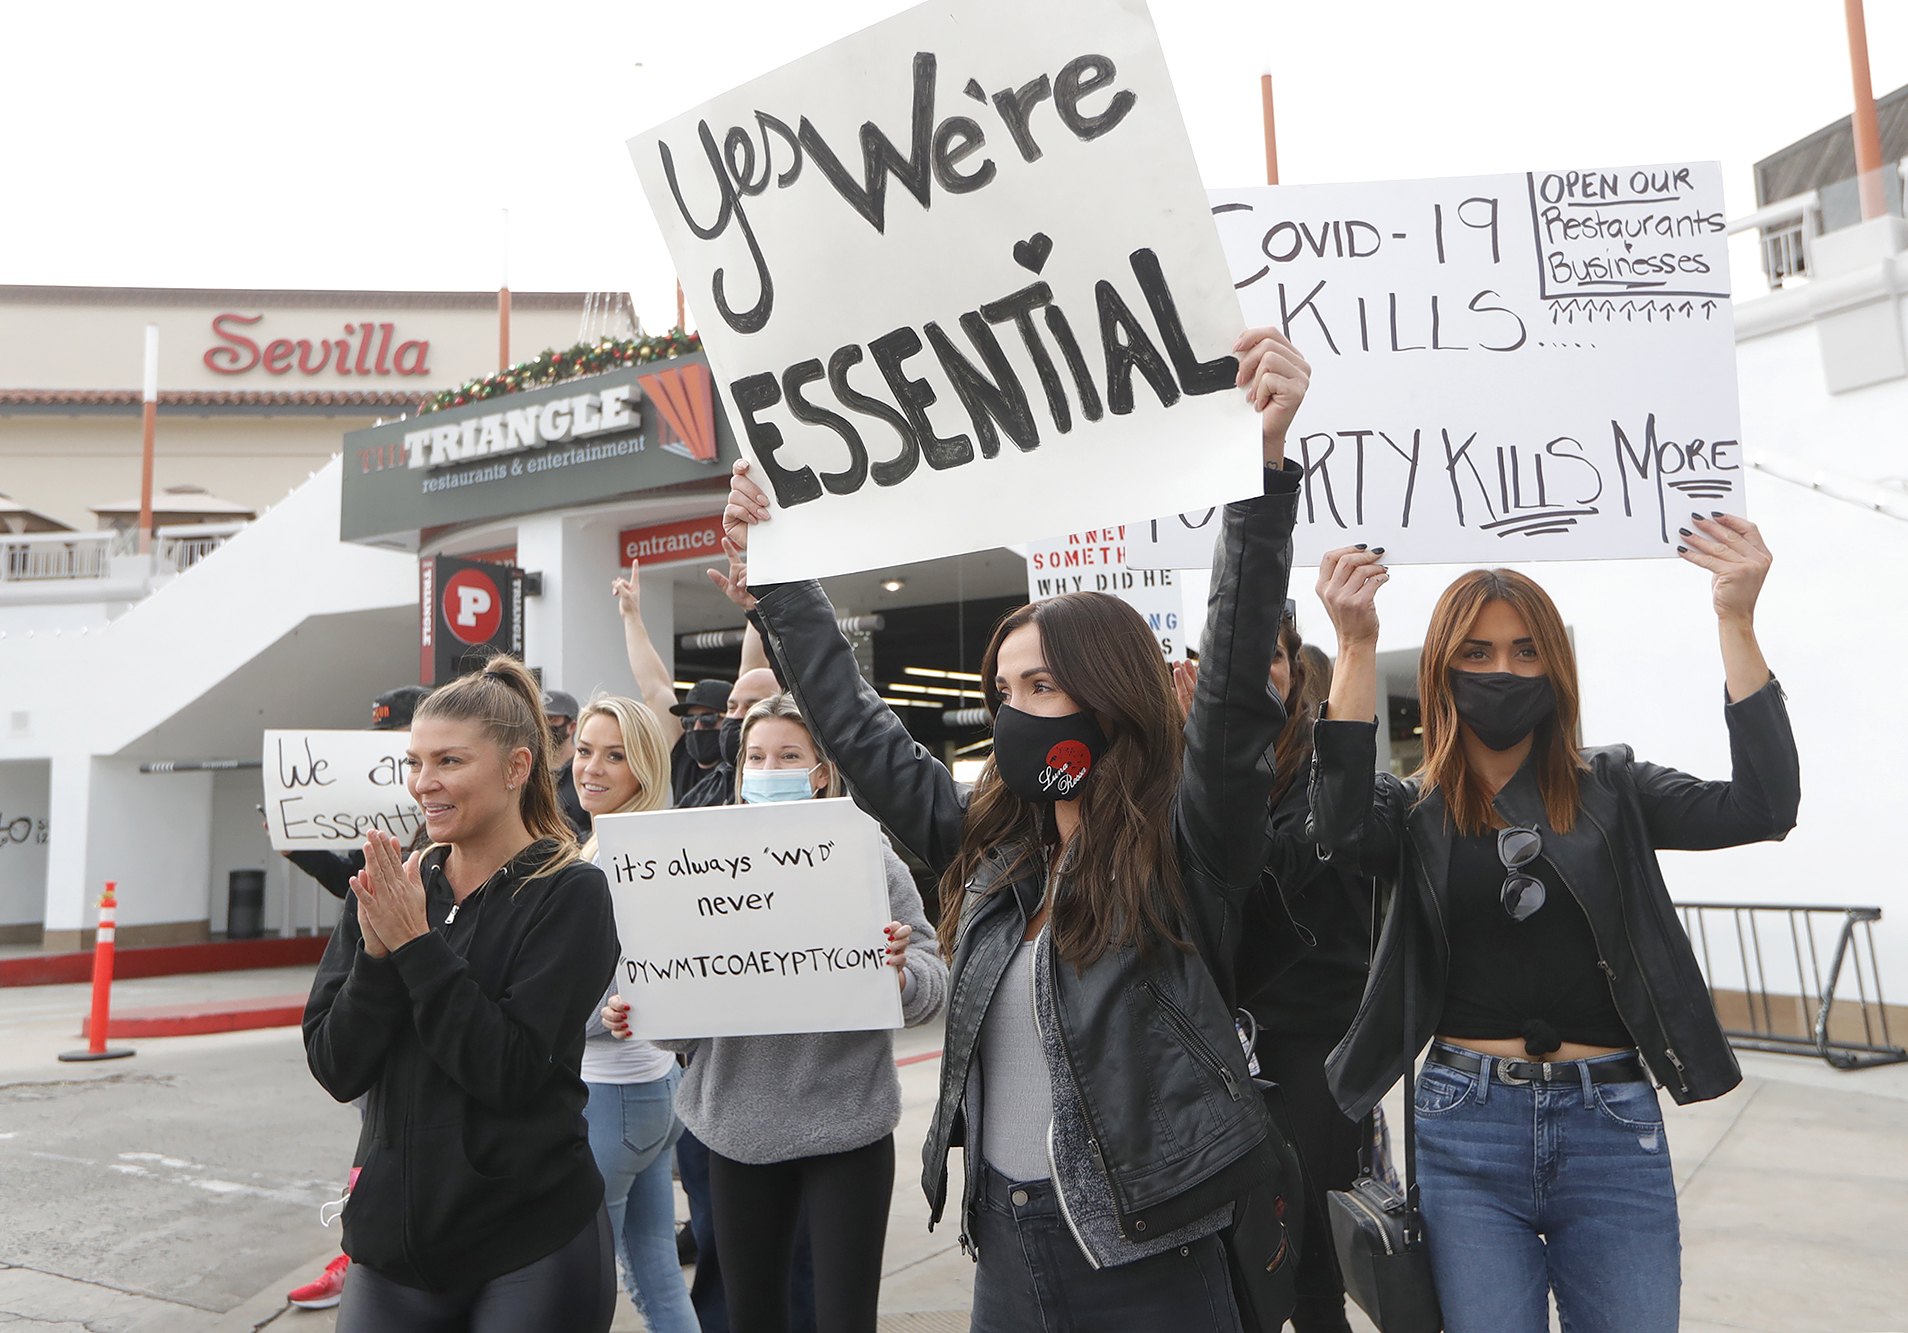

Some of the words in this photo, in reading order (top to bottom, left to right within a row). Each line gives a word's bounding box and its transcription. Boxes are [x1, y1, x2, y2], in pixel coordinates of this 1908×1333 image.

[800, 51, 1138, 235] We're
[1540, 170, 1618, 203] OPEN
[1629, 167, 1694, 194] OUR
[1540, 205, 1726, 244] Restaurants
[1548, 249, 1711, 283] Businesses
[203, 313, 431, 376] Sevilla
[729, 246, 1240, 510] ESSENTIAL
[404, 384, 642, 469] TRIANGLE
[422, 465, 507, 494] restaurants
[511, 462, 523, 477] &
[527, 434, 647, 476] entertainment
[1442, 428, 1603, 528] KILLS
[1611, 413, 1740, 544] MORE
[626, 529, 716, 559] entrance
[1033, 547, 1126, 571] SOMETH
[1037, 575, 1082, 596] WHY
[1096, 572, 1133, 591] DID
[1144, 569, 1173, 587] HE
[422, 568, 432, 646] TRIANGLE
[457, 585, 492, 627] P
[279, 736, 337, 789] We
[368, 755, 409, 786] ar
[280, 796, 422, 840] Essenti
[668, 848, 752, 879] always
[697, 891, 775, 917] never
